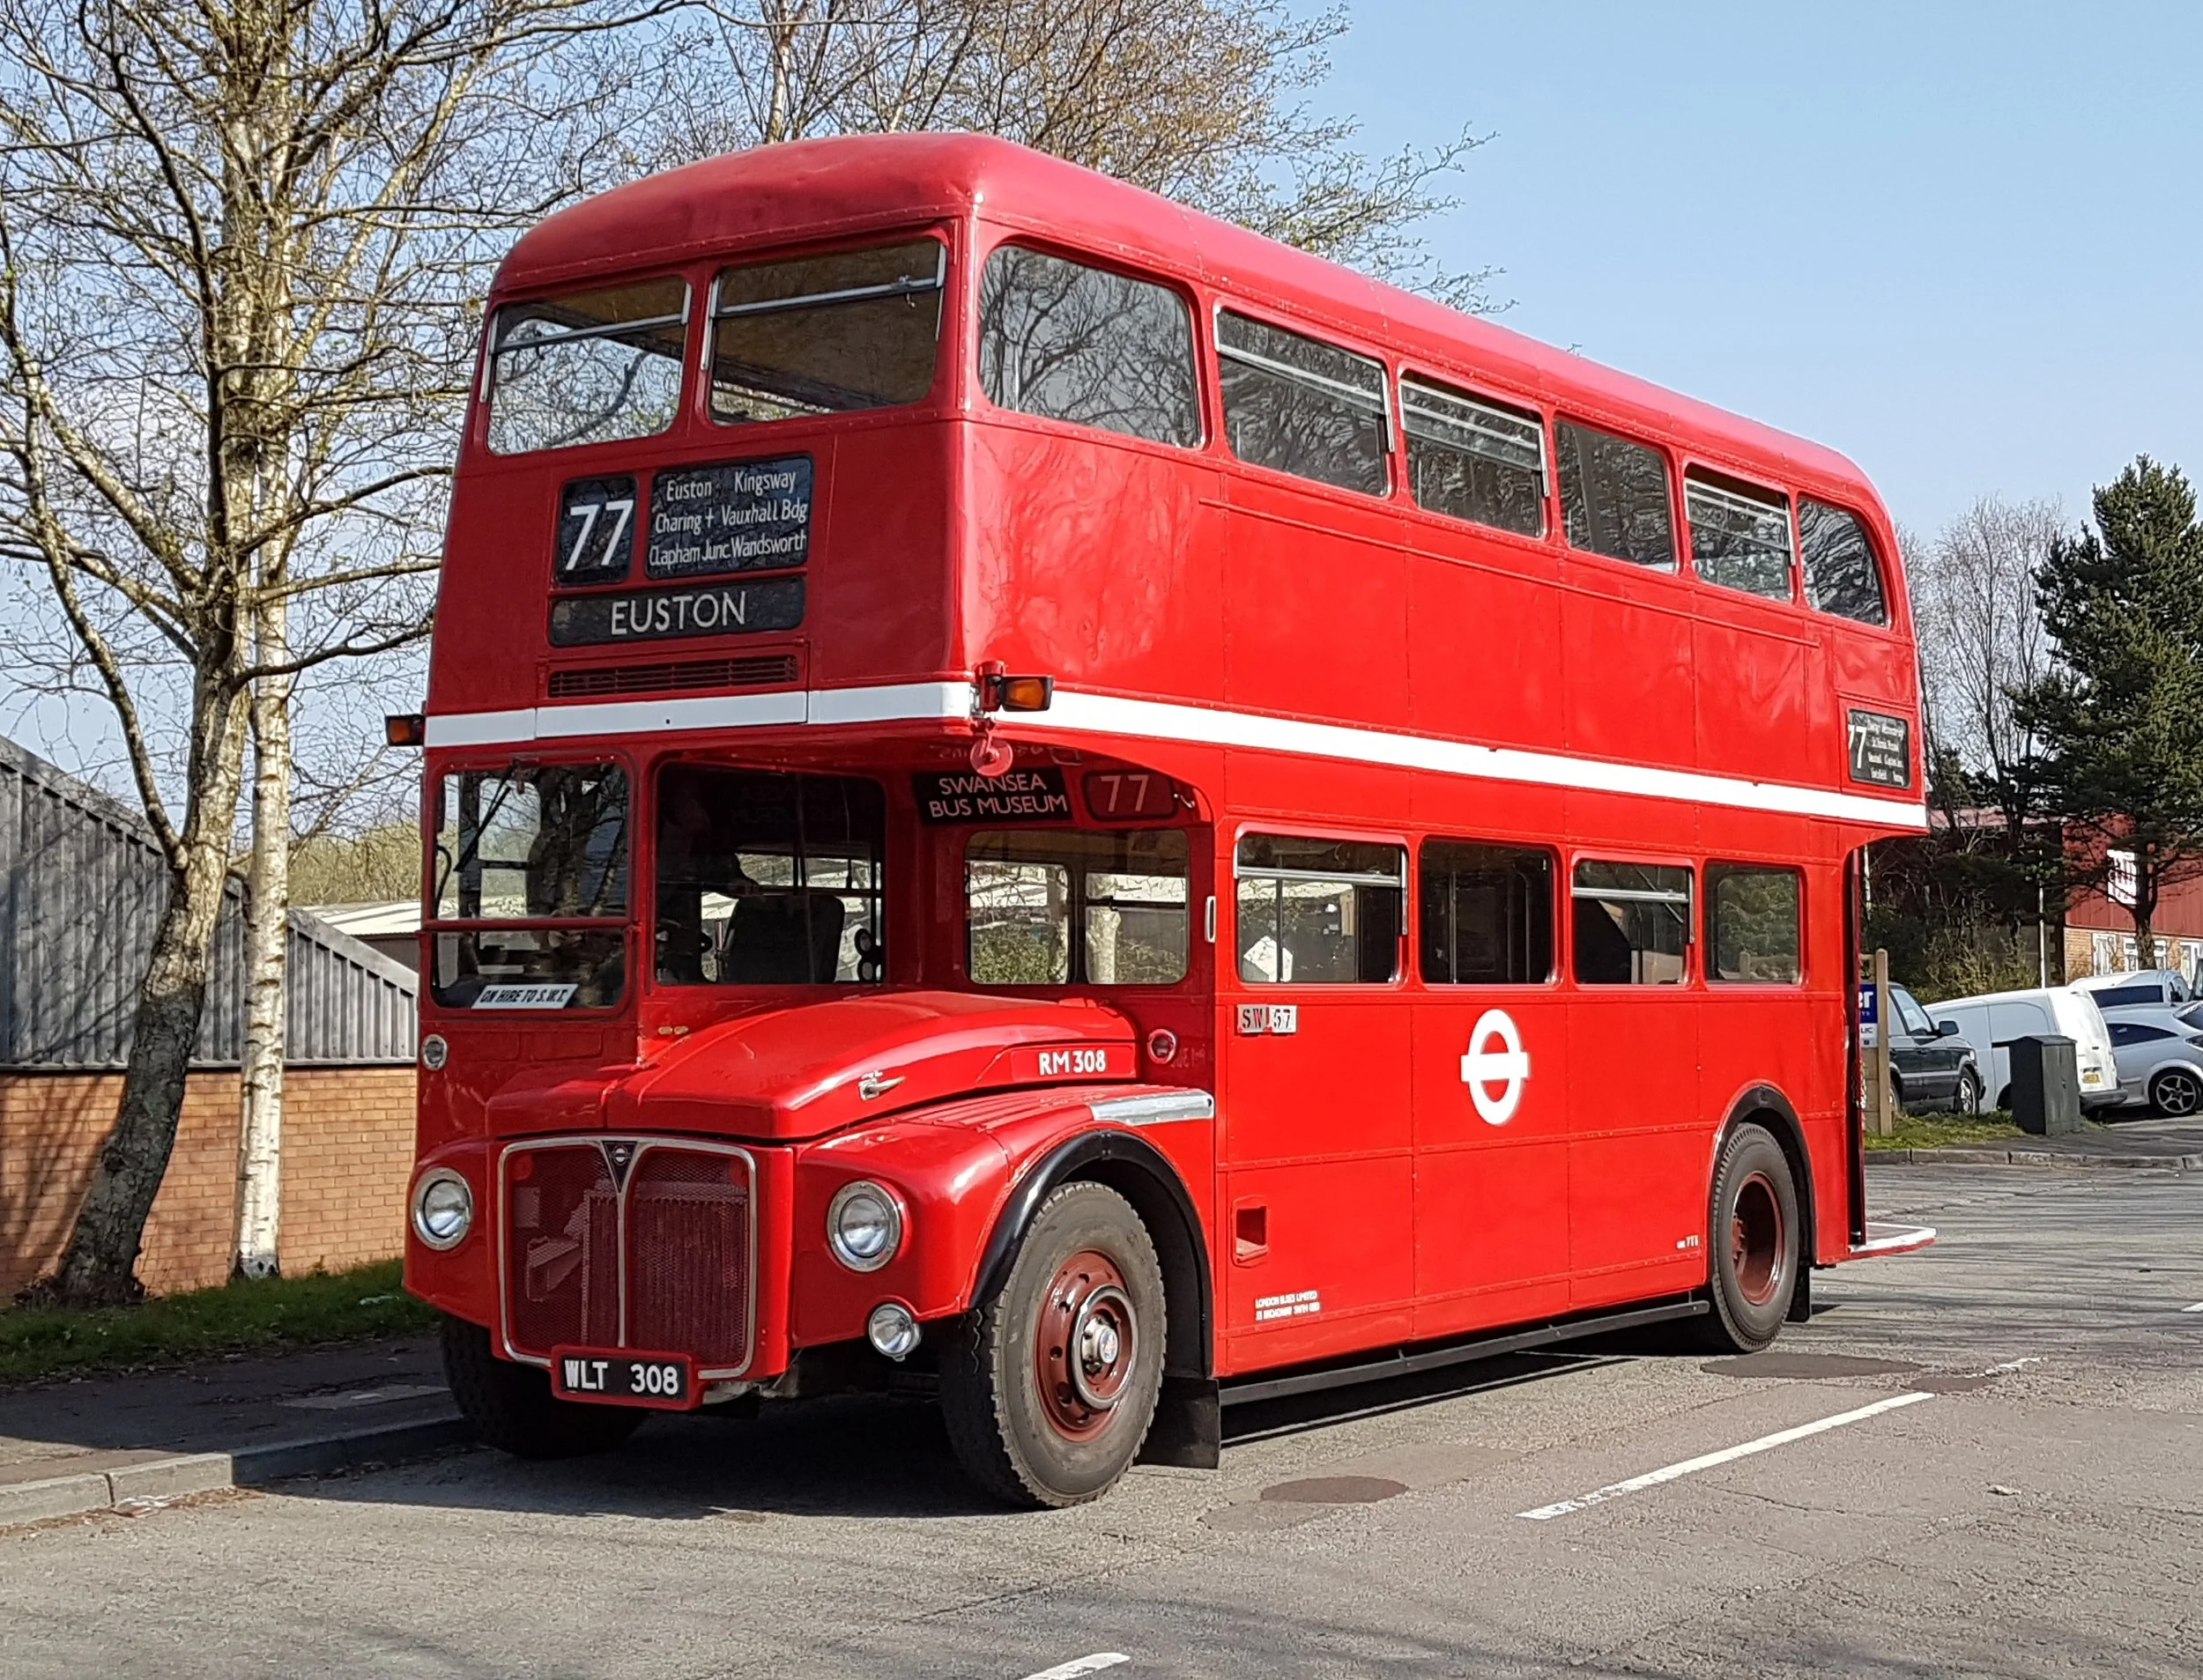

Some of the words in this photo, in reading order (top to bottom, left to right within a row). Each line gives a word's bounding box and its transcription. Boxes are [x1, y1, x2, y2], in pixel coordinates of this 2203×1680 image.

[666, 479, 712, 501] Euston
[734, 470, 796, 496] Kingsway
[655, 513, 702, 536] Charing
[722, 502, 778, 526] Vauxhall
[781, 497, 808, 523] Bdg
[566, 499, 634, 571] 77
[649, 543, 701, 570] Clapham
[701, 539, 731, 560] Junc
[731, 529, 806, 559] Wandsworth
[611, 590, 745, 635] EUSTON
[938, 772, 1047, 796] SWANSEA
[1101, 774, 1149, 812] 77
[929, 797, 973, 818] BUS
[976, 795, 1068, 817] MUSEUM
[480, 989, 499, 1003] ON
[495, 989, 524, 1003] HIRE
[521, 989, 538, 1004] TO
[1242, 1008, 1263, 1029] SW
[1273, 1008, 1291, 1029] 57
[1038, 1051, 1070, 1076] RM
[1072, 1049, 1107, 1073] 308
[564, 1359, 608, 1390] WLT
[630, 1364, 679, 1395] 308
